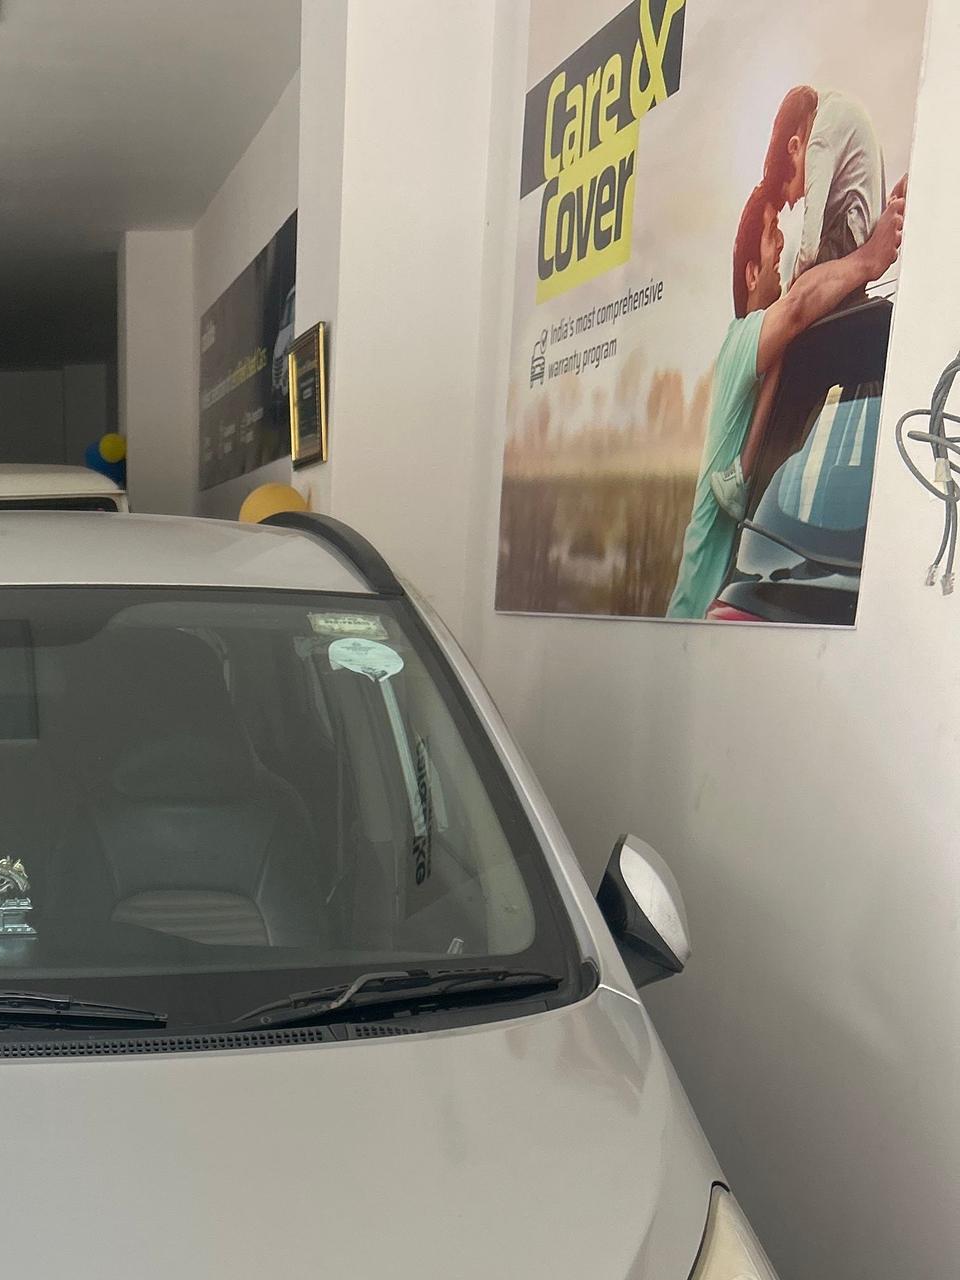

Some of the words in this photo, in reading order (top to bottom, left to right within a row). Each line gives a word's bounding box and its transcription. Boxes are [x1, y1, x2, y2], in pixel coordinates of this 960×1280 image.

[544, 53, 622, 181] Care
[629, 0, 685, 119] &
[537, 150, 635, 280] Cover
[548, 349, 581, 379] warranty
[581, 338, 617, 374] program
[550, 316, 575, 345] India's
[575, 306, 595, 335] most
[596, 277, 663, 325] comprehensive
